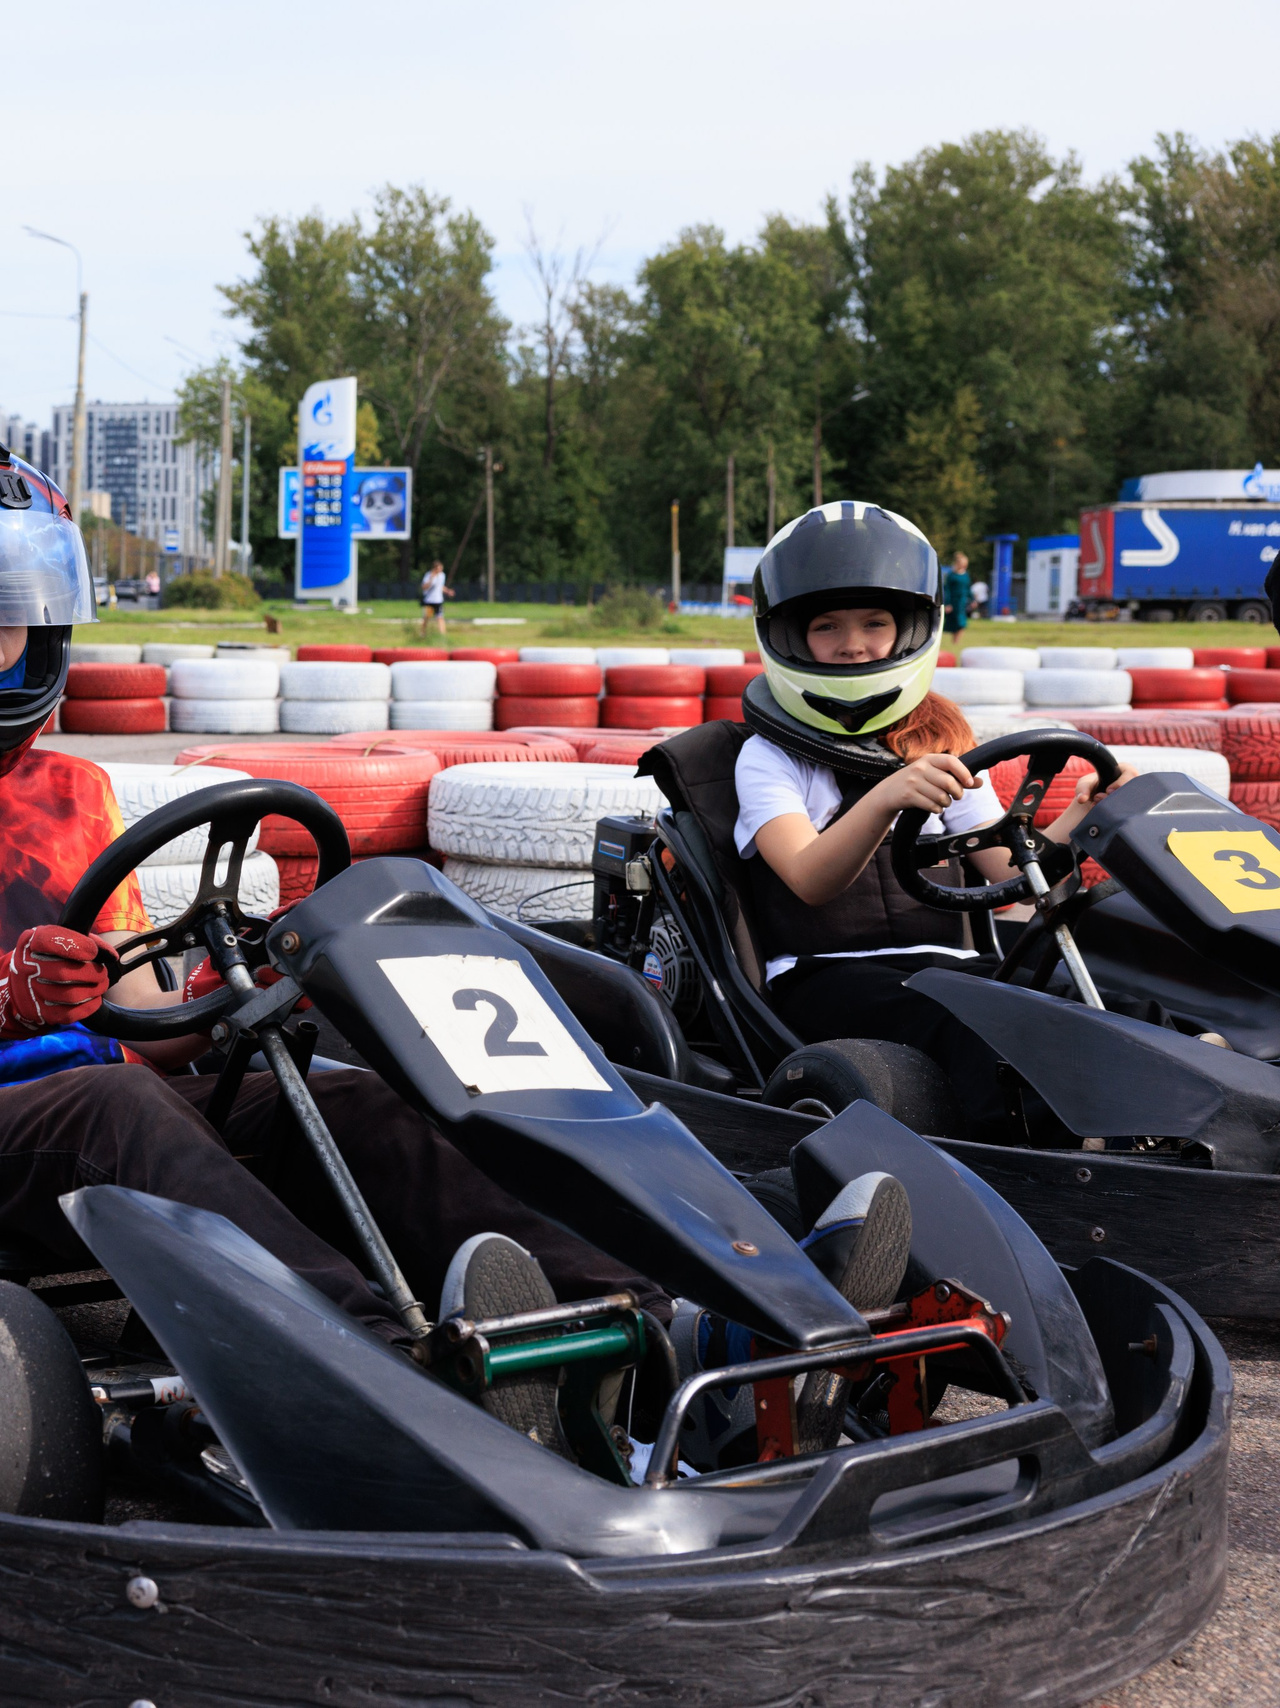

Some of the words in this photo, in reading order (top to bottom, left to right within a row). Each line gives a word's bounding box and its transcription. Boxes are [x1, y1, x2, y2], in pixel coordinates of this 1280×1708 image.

[1213, 850, 1280, 890] 3
[188, 962, 203, 982] ONE
[452, 988, 549, 1057] 2
